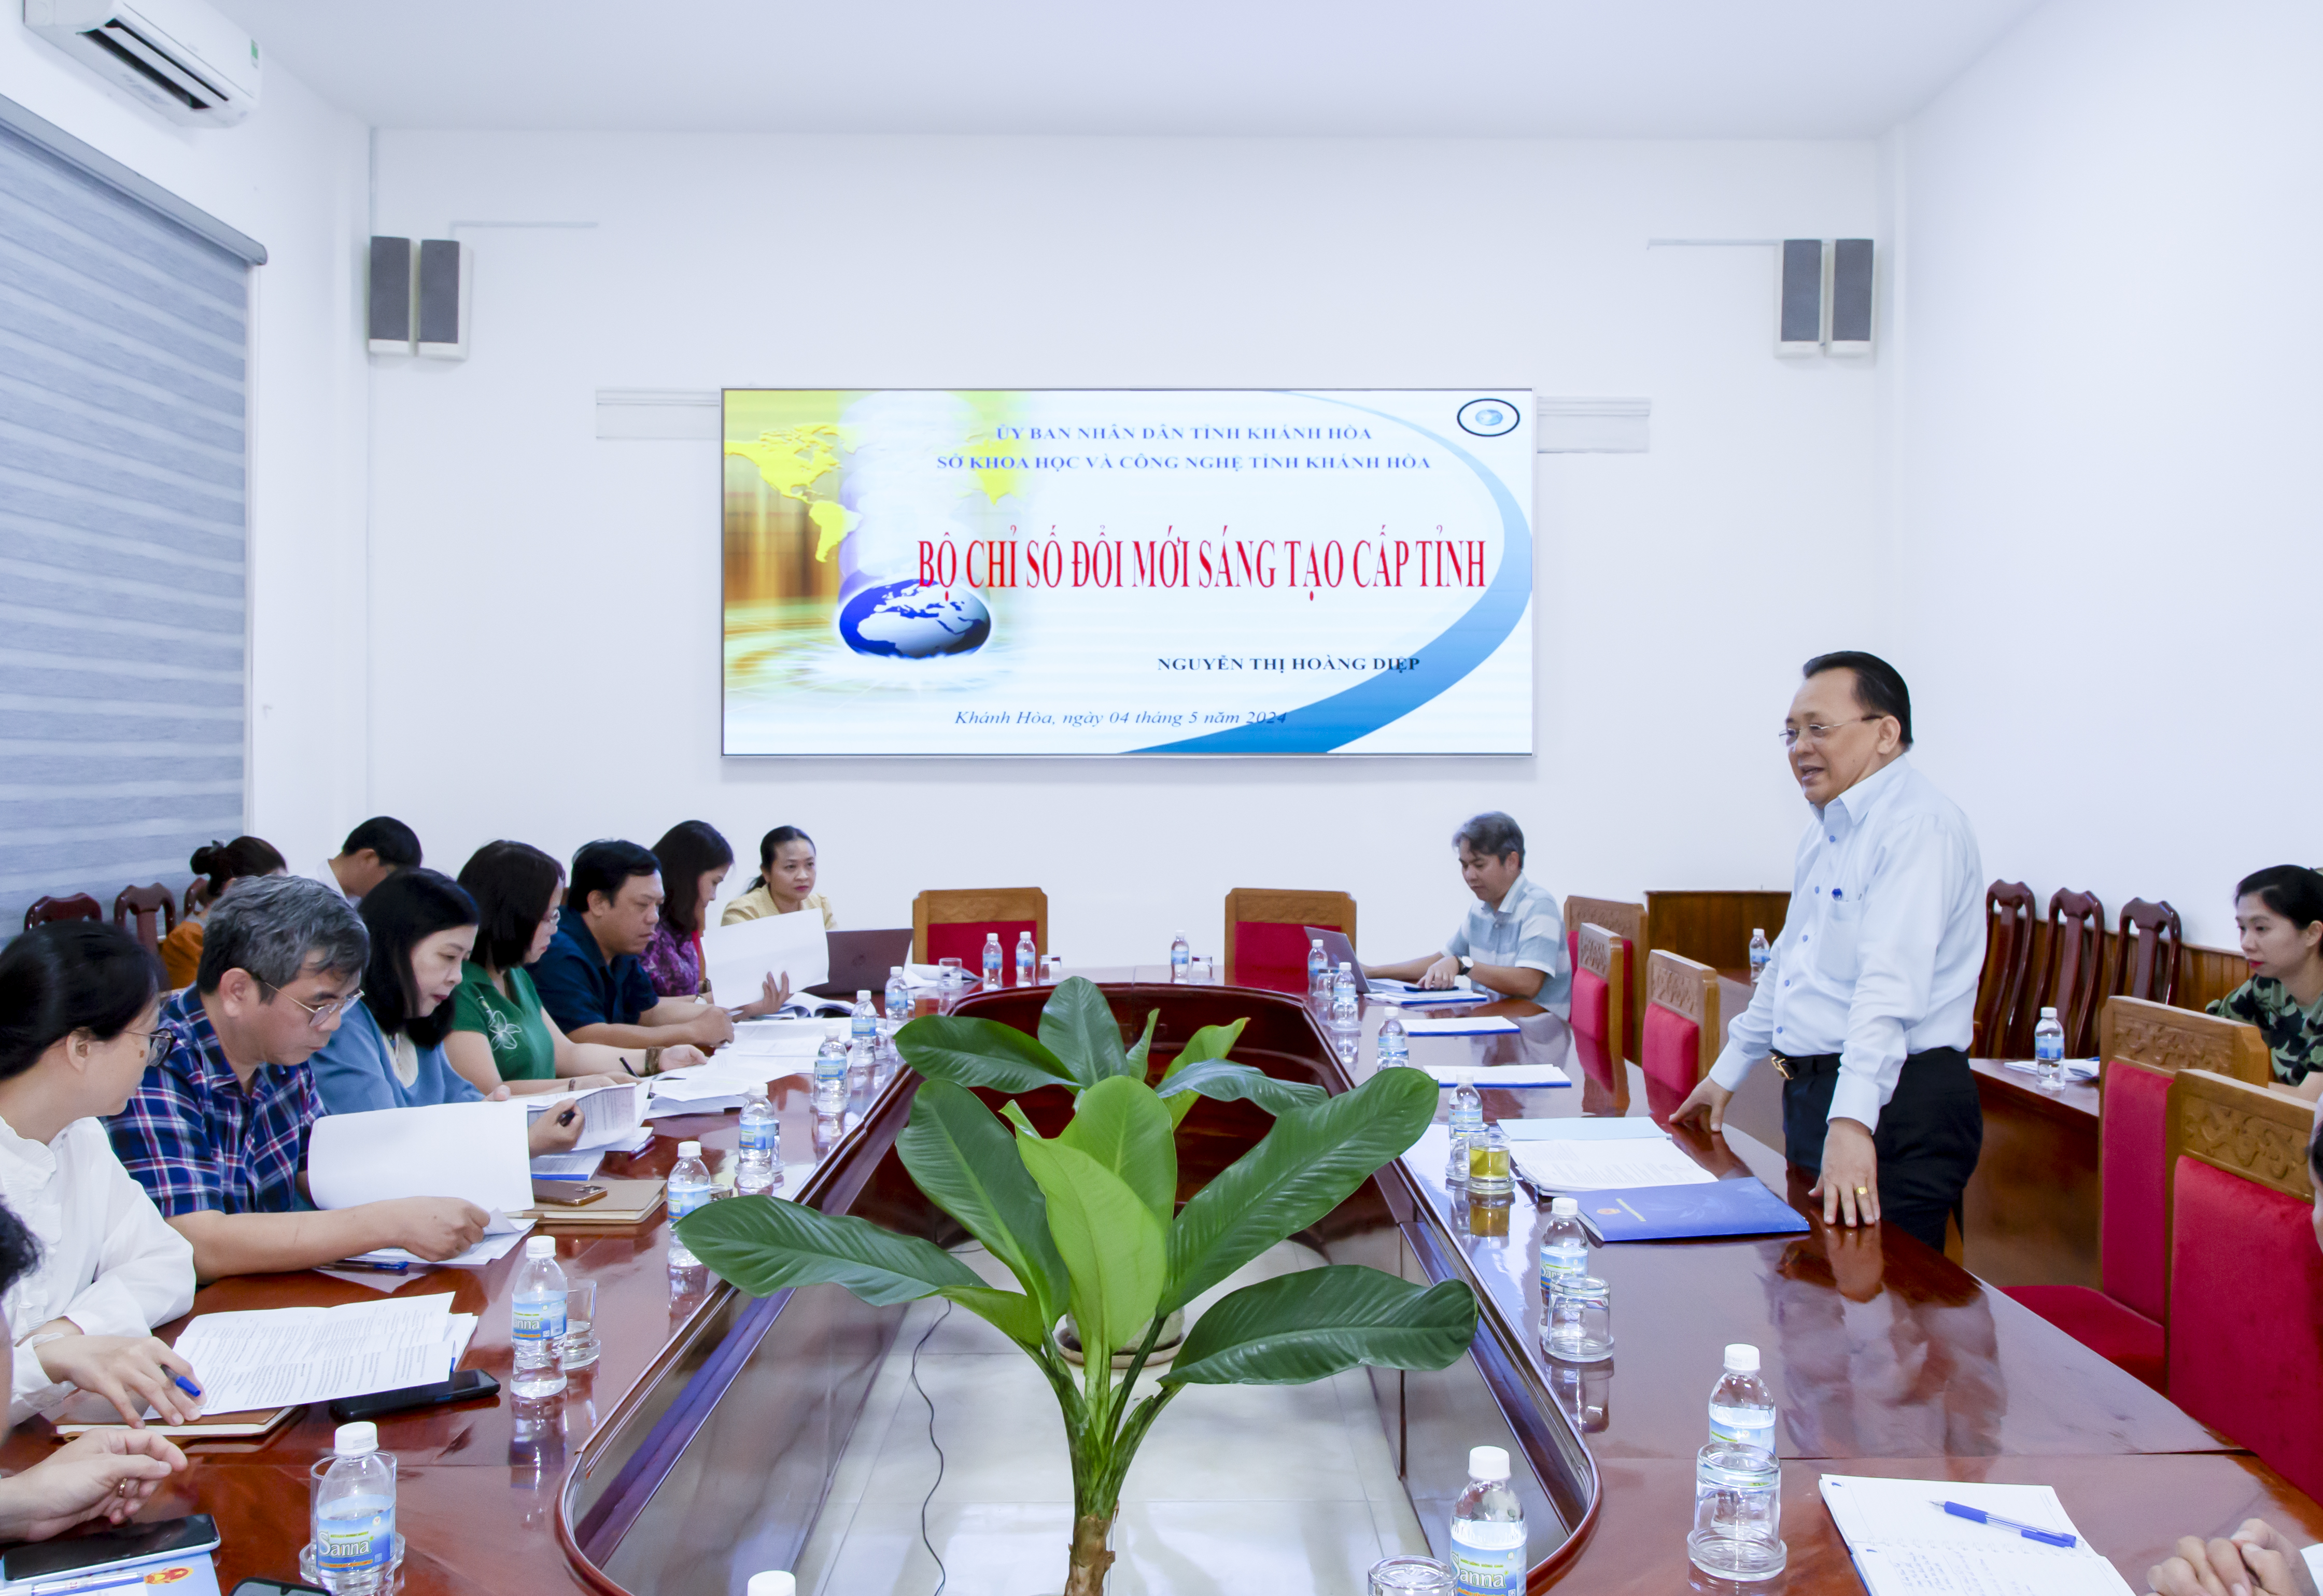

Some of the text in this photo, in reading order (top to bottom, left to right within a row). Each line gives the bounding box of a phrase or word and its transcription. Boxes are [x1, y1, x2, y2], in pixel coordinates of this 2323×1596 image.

[996, 424, 1024, 440] ỦY
[1031, 427, 1071, 440] BAN
[1078, 423, 1135, 440] NHÂN
[1143, 423, 1183, 440] DÂN
[1248, 424, 1320, 440] KHÁNH
[1329, 424, 1372, 440] HÒA
[969, 456, 1030, 469] KHOA
[1035, 456, 1080, 472] HỌC
[1086, 453, 1114, 469] VÀ
[1120, 453, 1178, 469] CÔNG
[1186, 454, 1243, 472] NGHỆ
[1306, 453, 1379, 469] KHÁNH
[1387, 453, 1431, 469] HÒA
[918, 525, 1486, 602] BỘ CHỈ SỐ ĐỔI MỚI SÁNG TẠO CẤP TỈNH
[1158, 655, 1420, 673] NGUYỄN THỊ HOÀNG DIỆP
[954, 711, 1287, 727] Khánh Hòa, ngày 04 tháng 5 năm 2024
[318, 1531, 371, 1557] Sanna
[1452, 1551, 1506, 1588] Sanna
